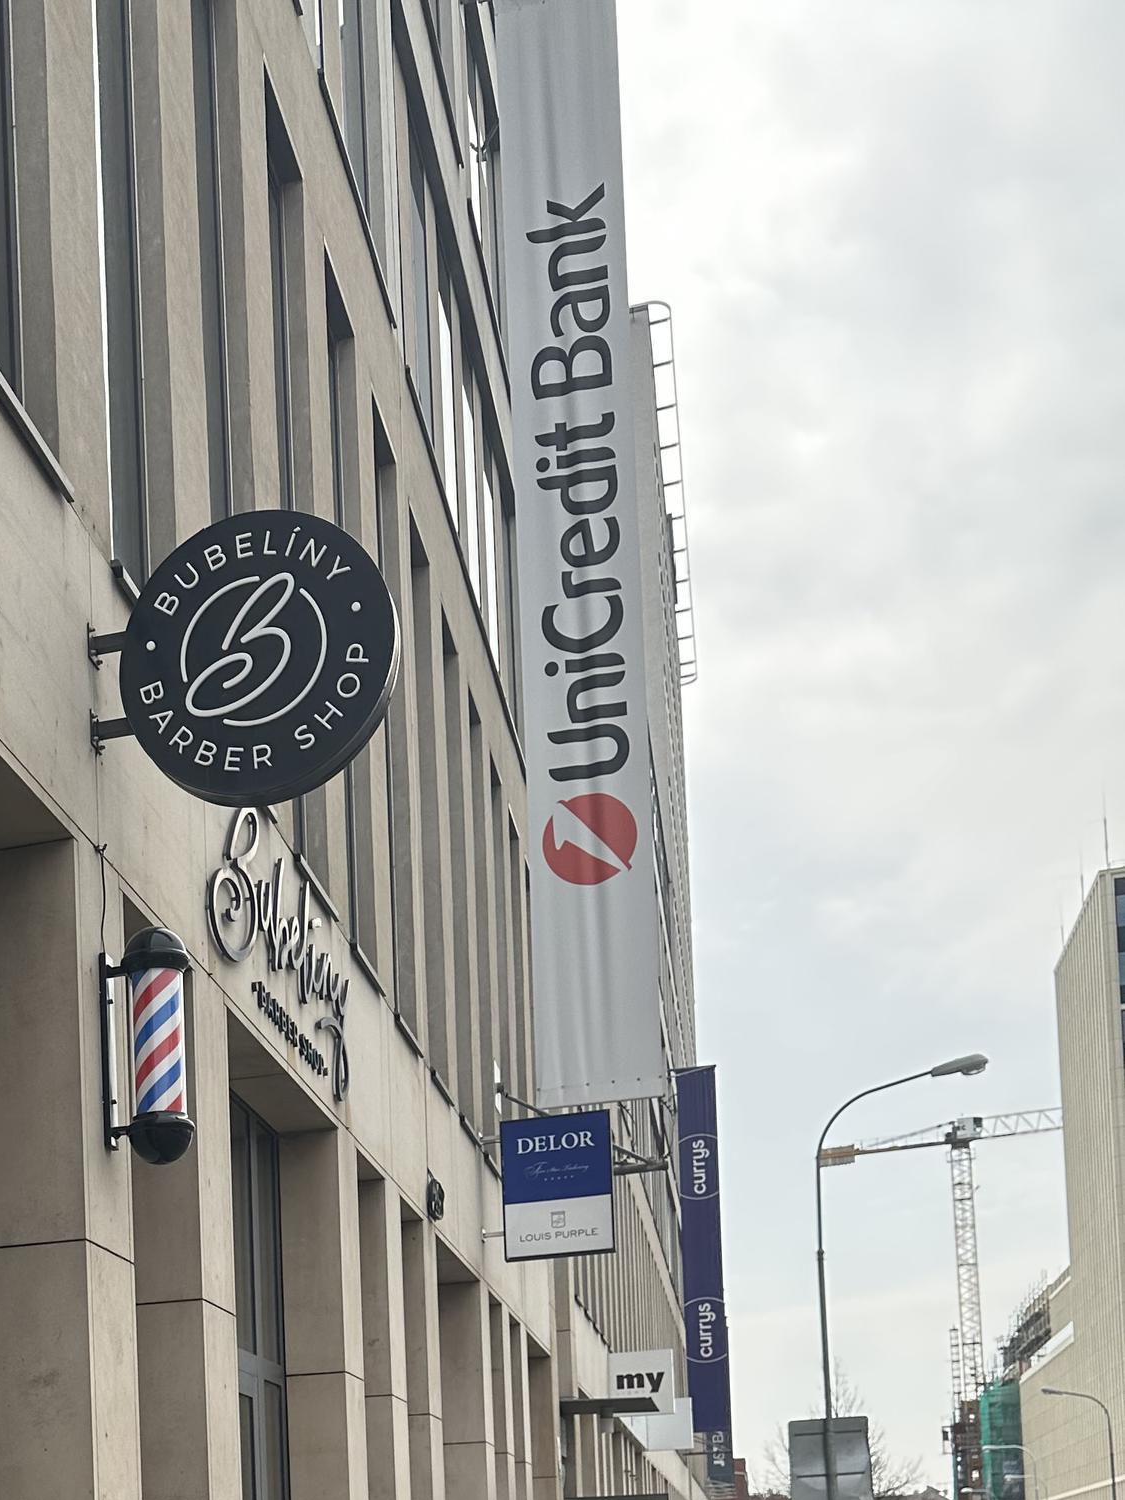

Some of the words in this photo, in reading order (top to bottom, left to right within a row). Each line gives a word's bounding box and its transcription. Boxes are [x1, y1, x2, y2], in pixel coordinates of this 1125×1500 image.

[525, 181, 615, 402] Bank
[153, 526, 352, 617] BUBELÍNY
[535, 409, 631, 783] UniCredit
[138, 681, 274, 772] BARBER
[293, 642, 370, 750] SHOP
[516, 1130, 595, 1155] DELOR
[692, 1139, 710, 1195] currys
[519, 1231, 552, 1243] LOUIS
[555, 1227, 599, 1239] PURPLE
[698, 1302, 716, 1358] currys
[616, 1371, 665, 1393] my
